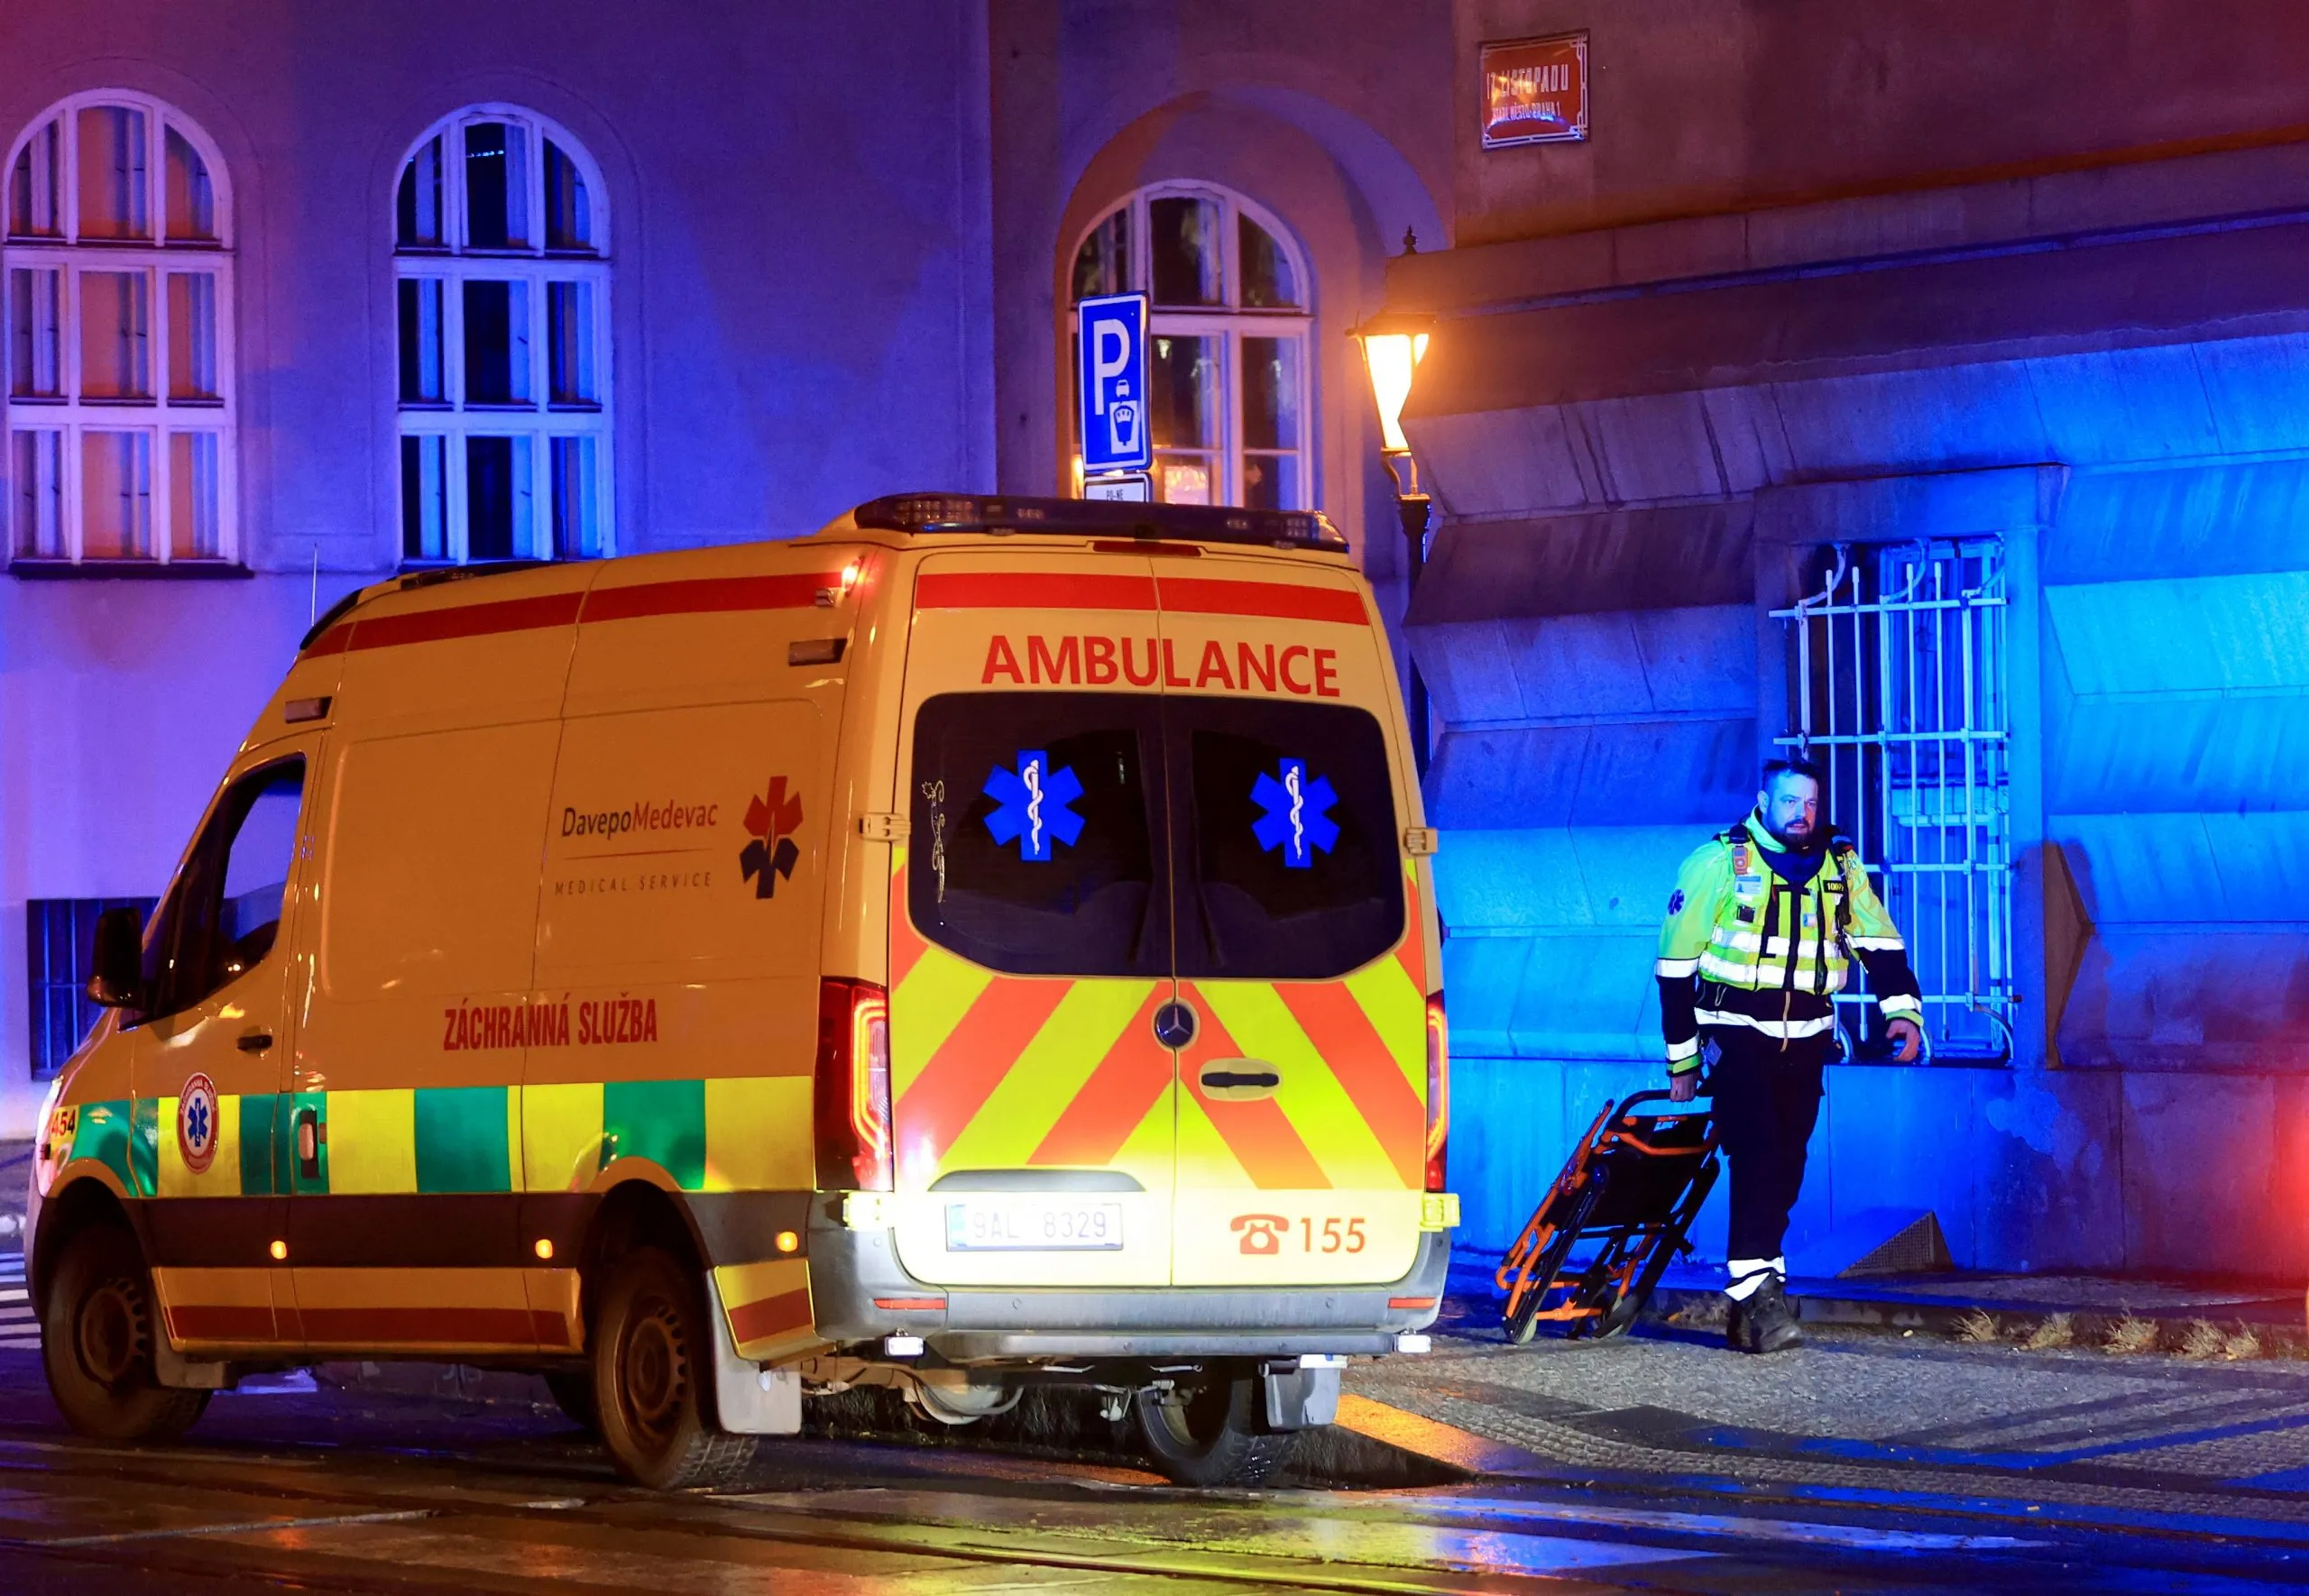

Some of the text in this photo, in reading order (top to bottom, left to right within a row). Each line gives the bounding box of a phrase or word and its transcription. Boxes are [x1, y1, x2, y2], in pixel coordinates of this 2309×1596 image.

[1093, 318, 1130, 416] P
[981, 635, 1340, 698] AMBULANCE
[561, 799, 718, 840] DavepoMedevac
[555, 871, 712, 896] MEDICAL SERVICE
[444, 992, 658, 1050] ZÁCHRANNÁ SLUŽBA
[973, 1211, 1106, 1238] 9AL 8329
[1301, 1217, 1366, 1253] 155
